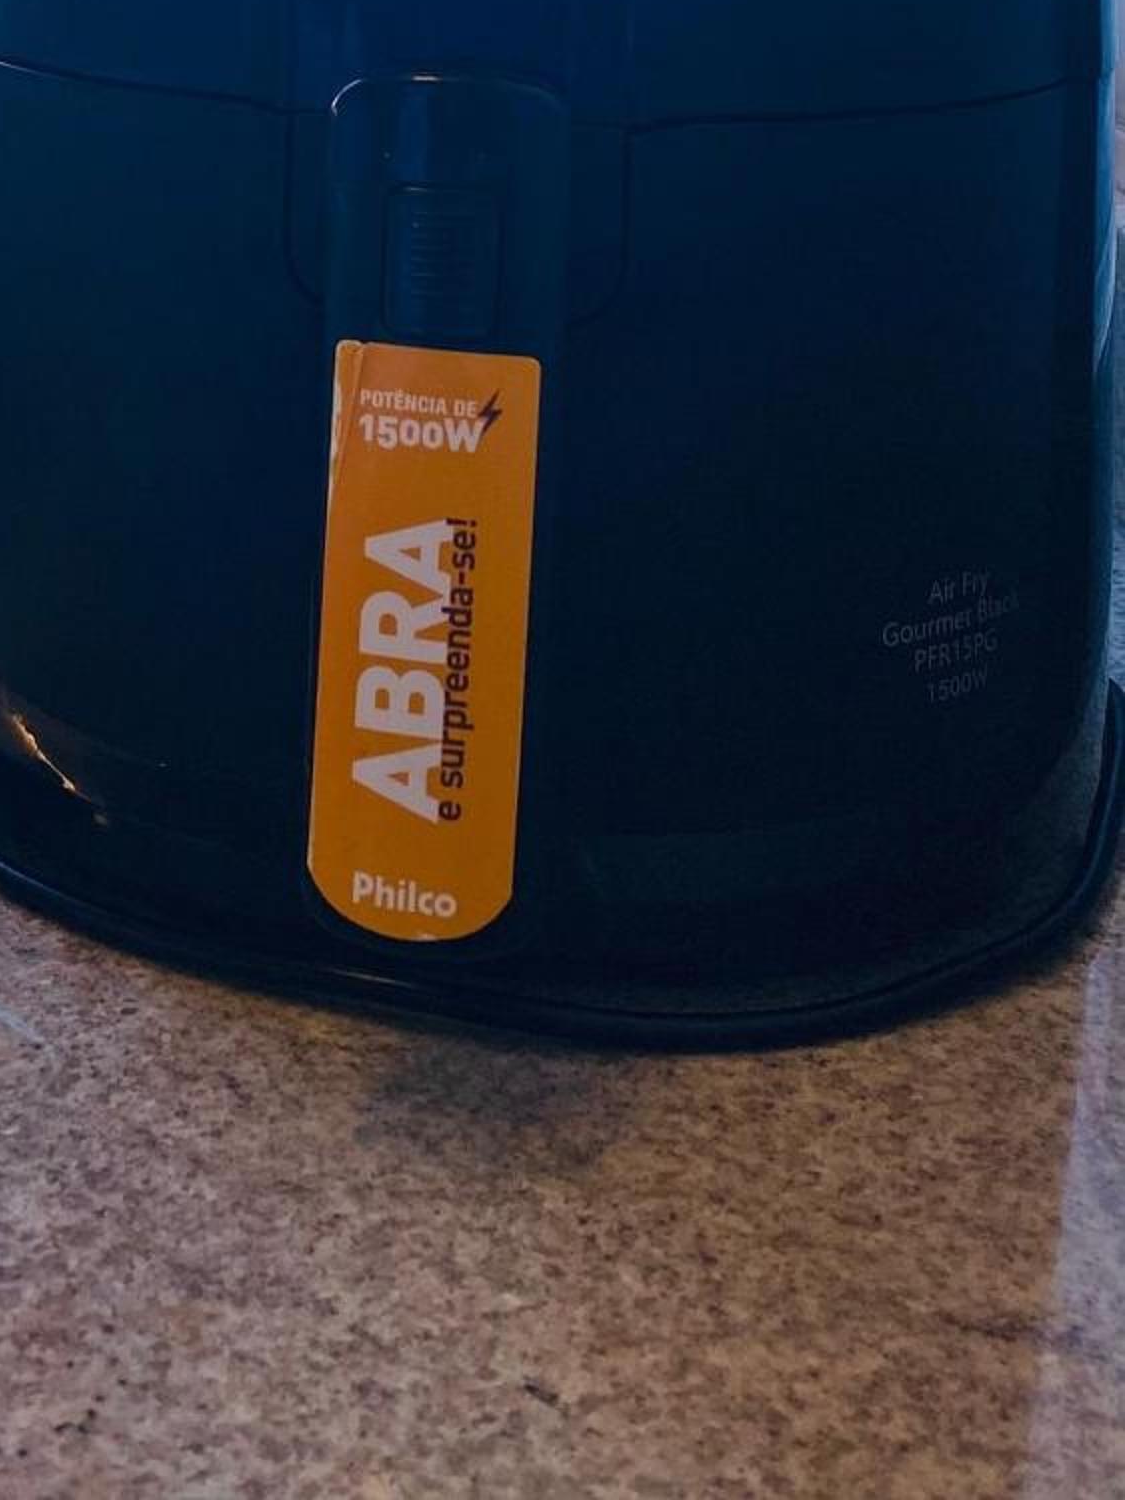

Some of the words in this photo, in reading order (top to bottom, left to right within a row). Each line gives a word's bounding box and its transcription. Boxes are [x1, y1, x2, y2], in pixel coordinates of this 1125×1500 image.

[360, 389, 447, 418] POTÊNCIA
[453, 399, 477, 419] DE
[360, 414, 484, 452] 1500W
[927, 577, 956, 604] Air
[882, 608, 973, 648] Gourmet
[352, 519, 455, 823] ABRA
[439, 517, 478, 790] surpreenda-se!
[927, 664, 988, 703] 1500W
[438, 802, 462, 822] e
[352, 869, 458, 919] Philco
